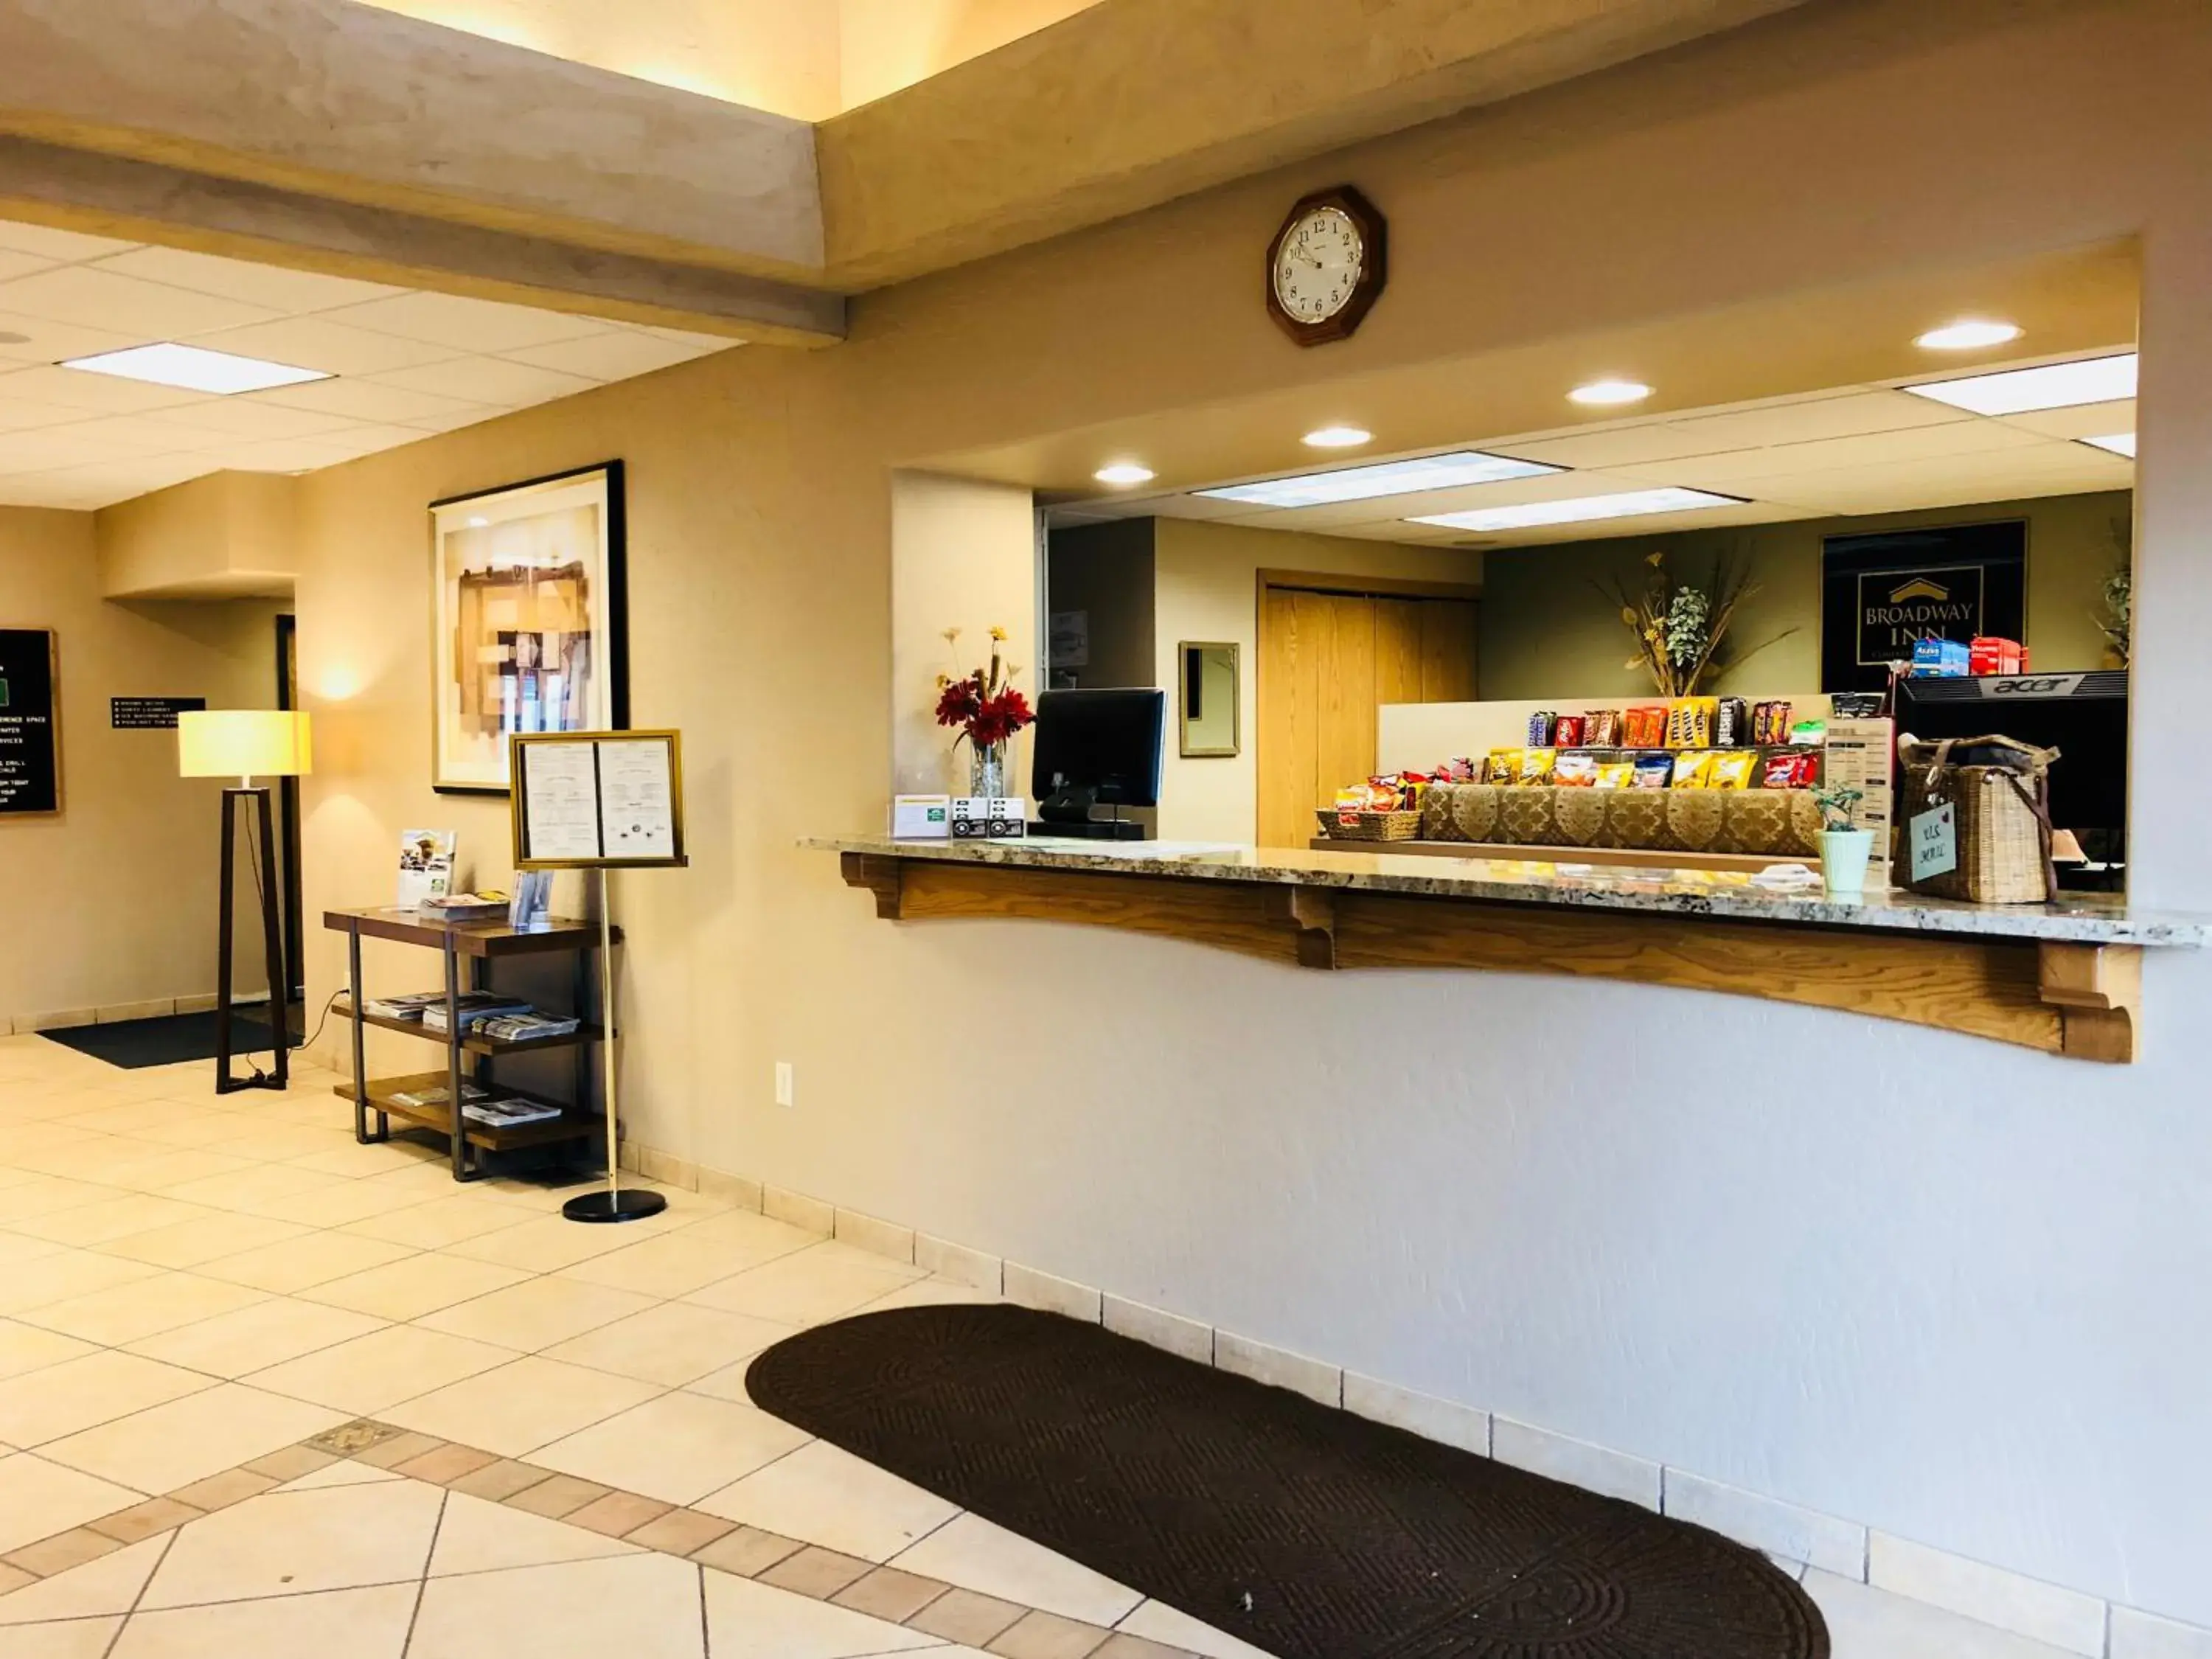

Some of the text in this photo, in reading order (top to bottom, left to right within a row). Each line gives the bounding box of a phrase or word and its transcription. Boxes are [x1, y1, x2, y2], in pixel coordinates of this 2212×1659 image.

[1314, 219, 1326, 233] 12
[1333, 223, 1338, 233] 1
[1299, 231, 1310, 242] 11
[1343, 233, 1350, 246] 2
[1347, 251, 1354, 263] 3
[1285, 267, 1292, 279] 9
[1341, 274, 1348, 285] 4
[1290, 286, 1297, 298] 8
[1332, 291, 1338, 302] 5
[1300, 298, 1307, 310] 7
[1315, 299, 1322, 310] 6
[1866, 603, 1973, 626] BROADWAY
[1891, 626, 1947, 646] INN
[1993, 678, 2070, 694] acer
